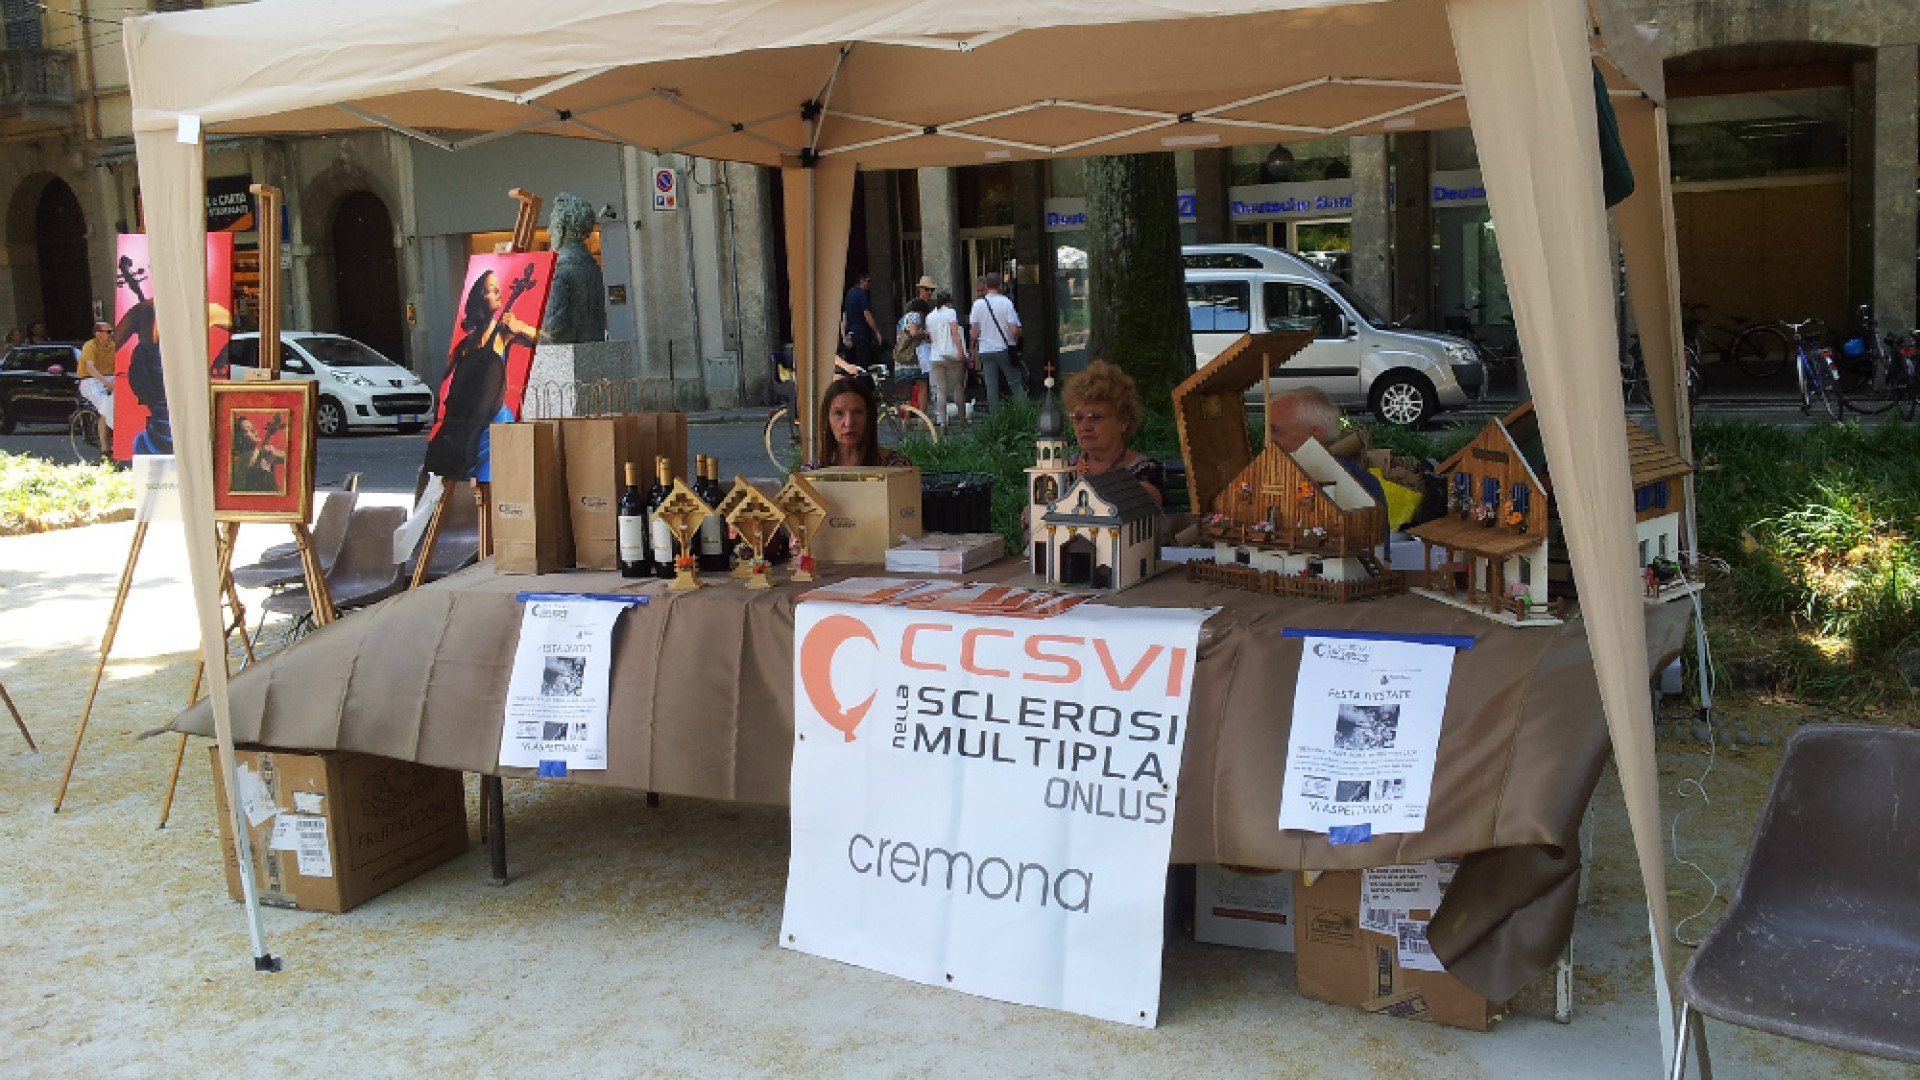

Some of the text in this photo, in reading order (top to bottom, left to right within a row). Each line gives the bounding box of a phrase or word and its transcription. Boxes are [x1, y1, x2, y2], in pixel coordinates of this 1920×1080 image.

[218, 193, 247, 205] CARTA
[1231, 197, 1312, 217] Deutsche
[1433, 186, 1486, 201] Deuts
[900, 622, 1188, 698] CCSVI
[892, 684, 909, 749] nella
[917, 685, 1180, 745] SCLEROSI
[913, 722, 1166, 784] MULTIPLA
[1044, 776, 1168, 825] ONLUS
[848, 832, 1094, 914] cremona
